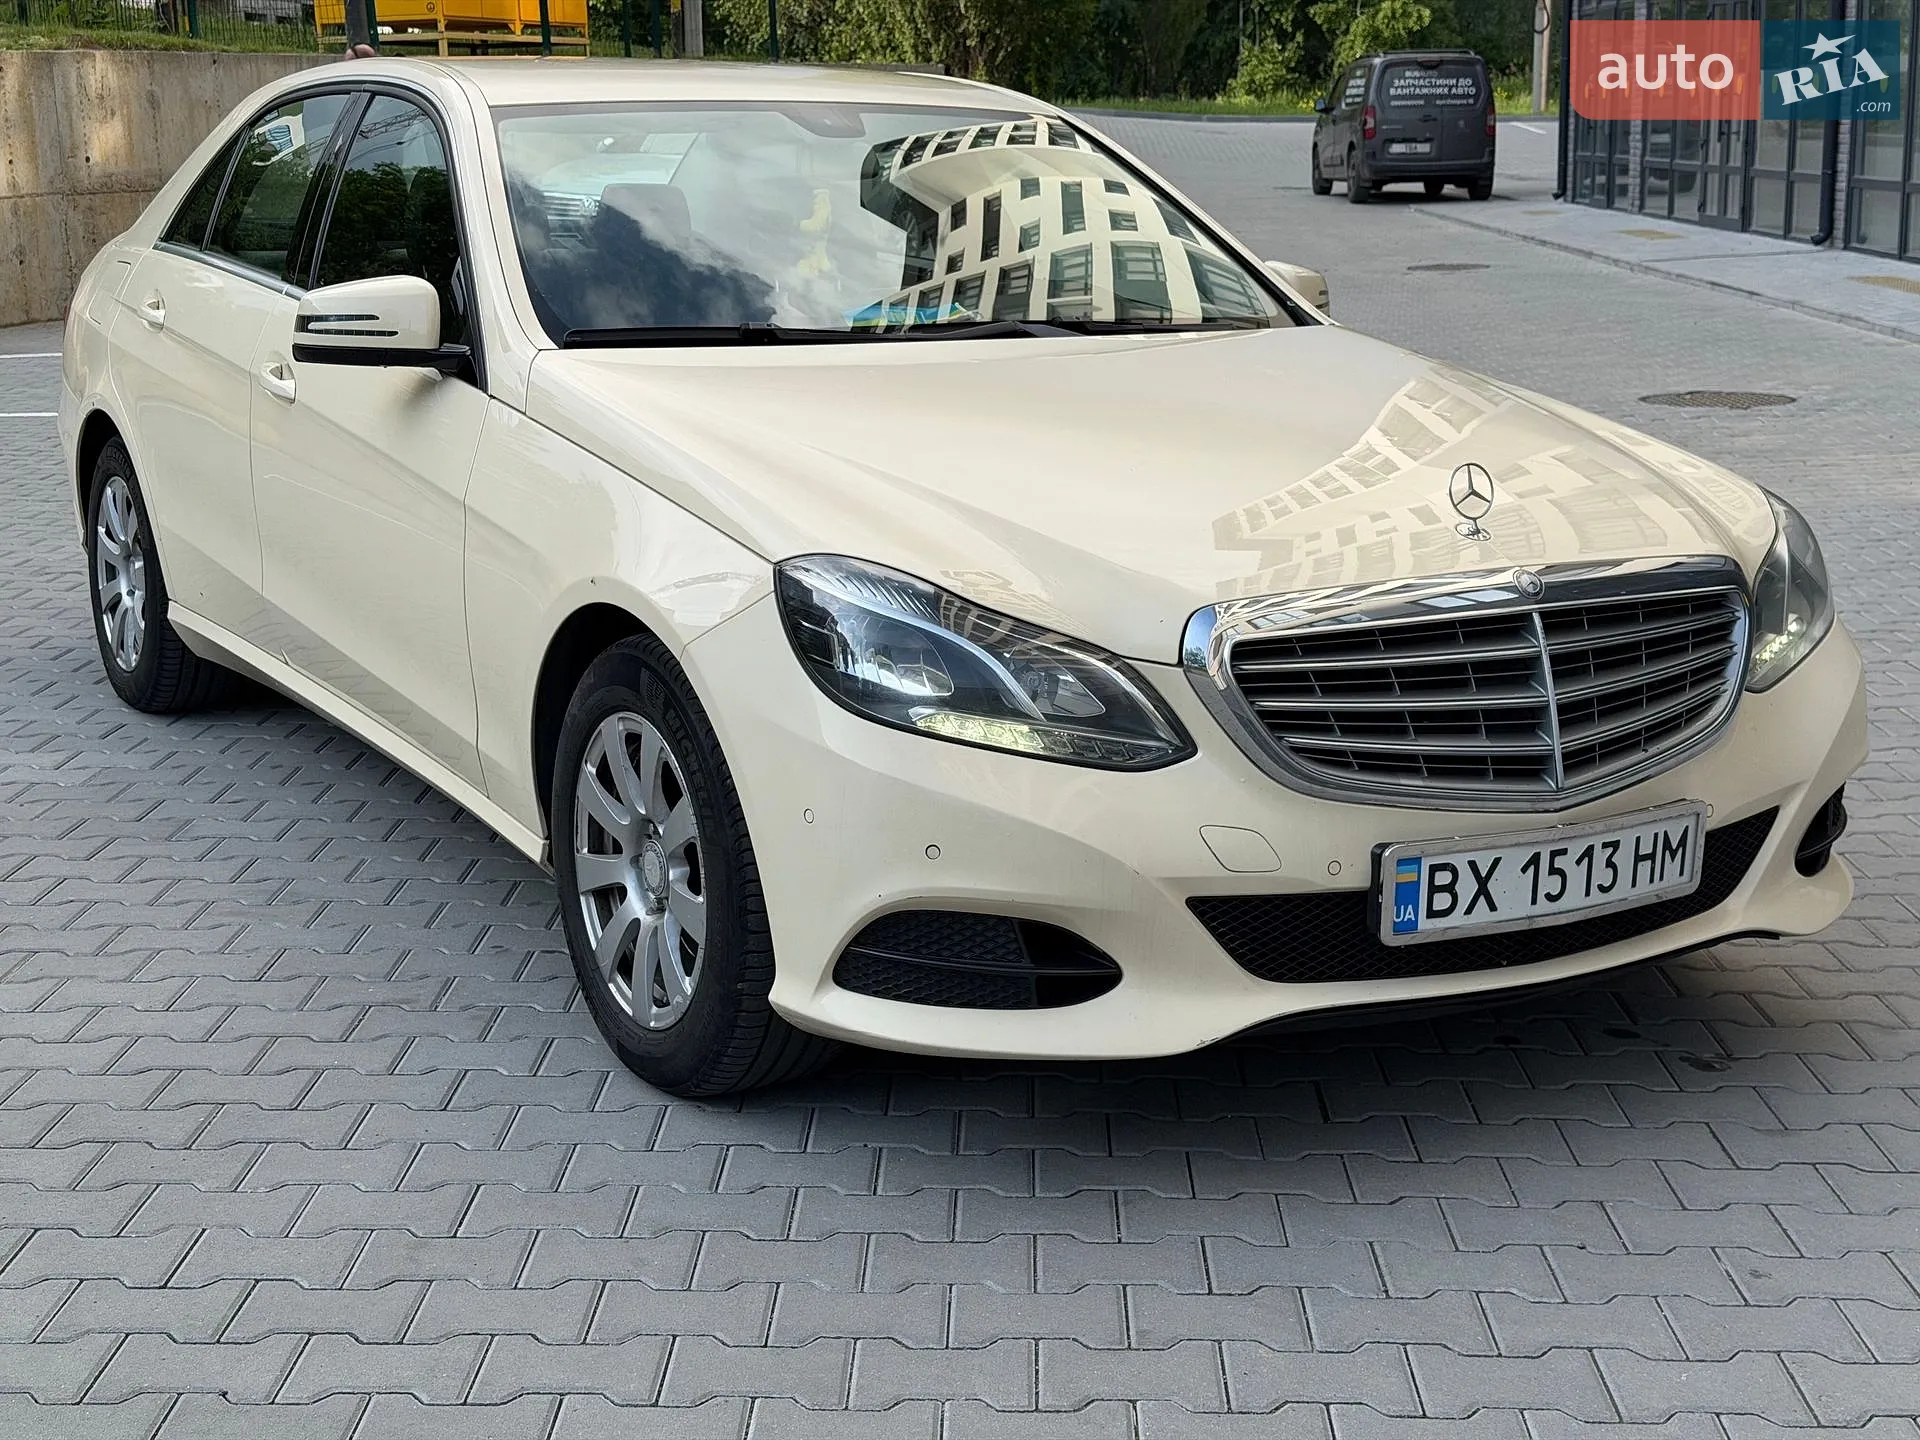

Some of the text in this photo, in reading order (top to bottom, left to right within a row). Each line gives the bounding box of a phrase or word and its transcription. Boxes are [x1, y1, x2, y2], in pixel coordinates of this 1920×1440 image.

[1393, 78, 1473, 87] ЗАПЧАСТИНИ ДО
[1389, 86, 1476, 96] ВАНТАЖНИХ АВТО
[1520, 839, 1622, 906] 1513
[1393, 904, 1415, 922] UA
